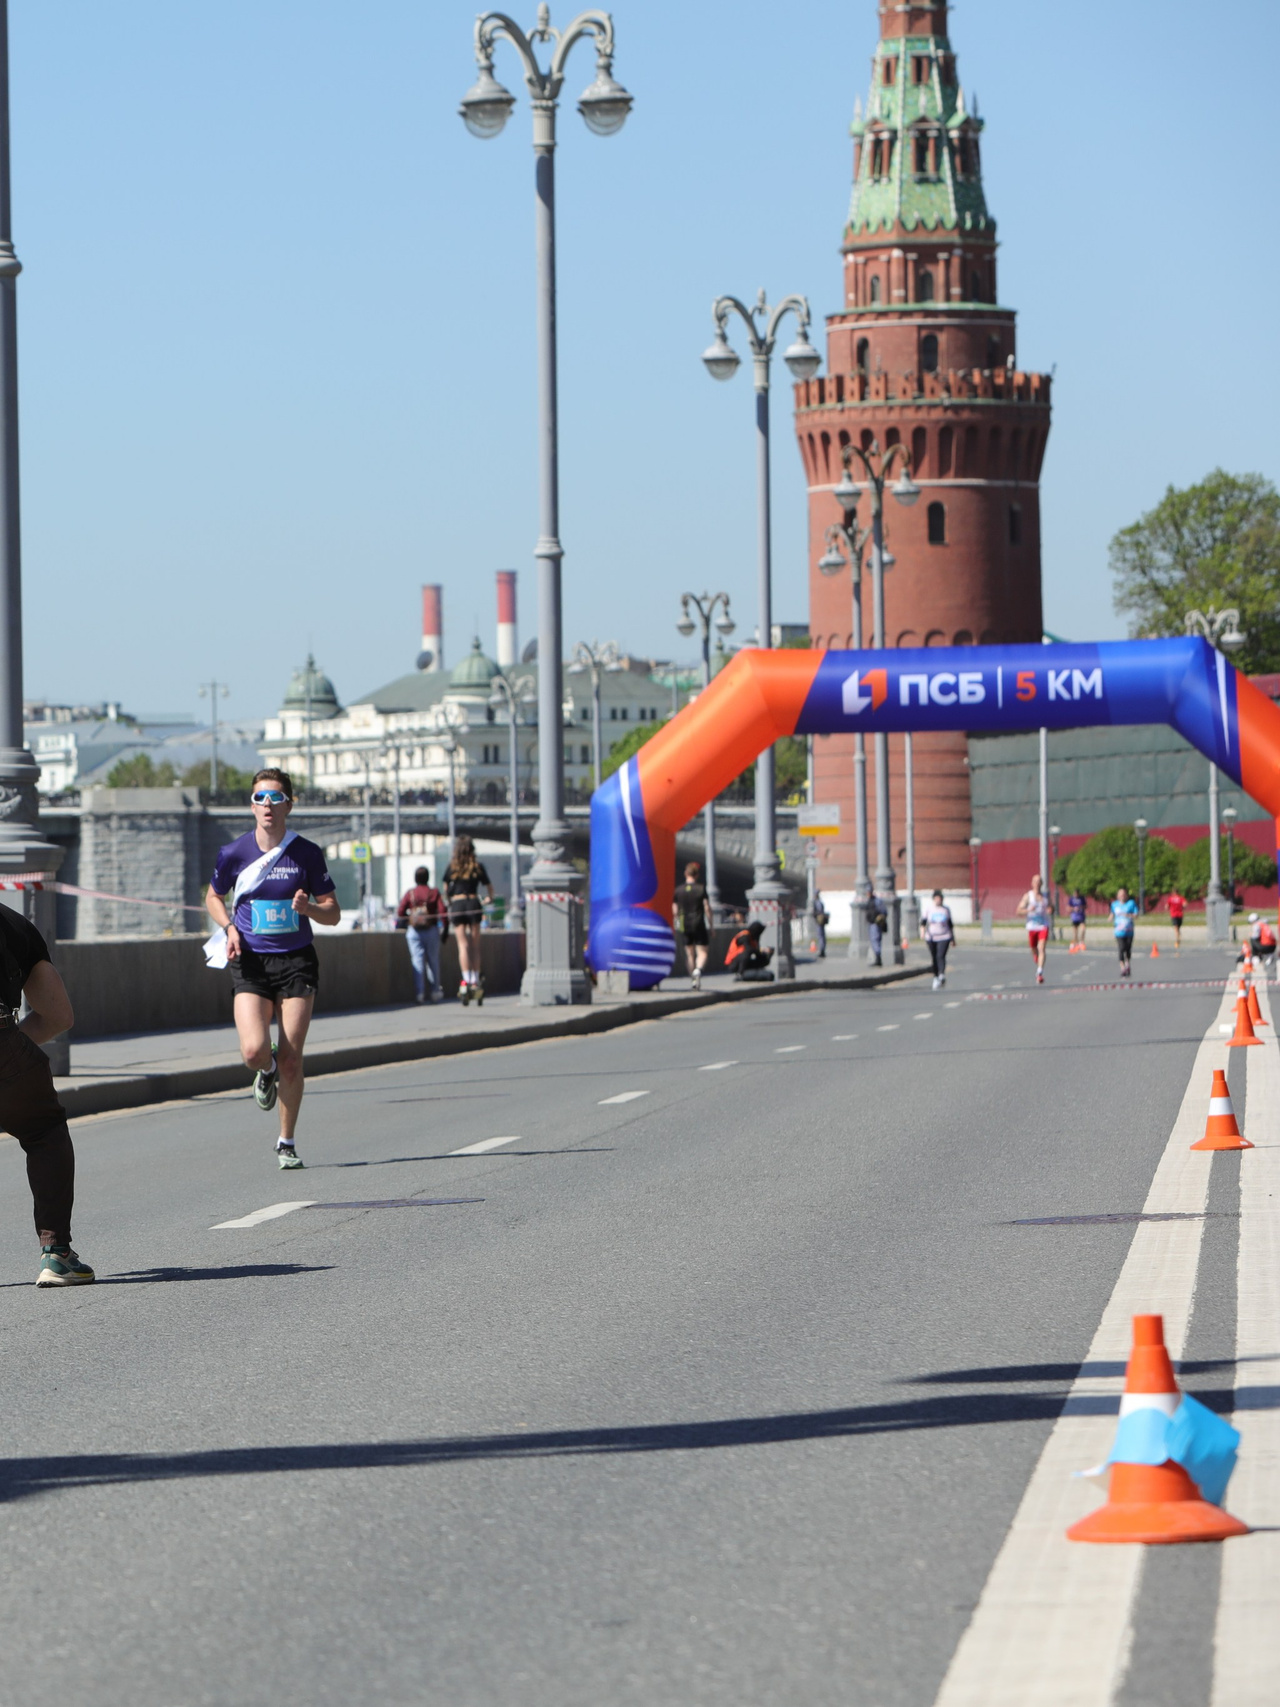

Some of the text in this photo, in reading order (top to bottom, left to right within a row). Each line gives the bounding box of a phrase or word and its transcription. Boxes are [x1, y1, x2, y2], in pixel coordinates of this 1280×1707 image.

[899, 671, 986, 706] ПСБ
[1015, 671, 1037, 702] 5
[271, 866, 299, 874] ТИВНАЯ
